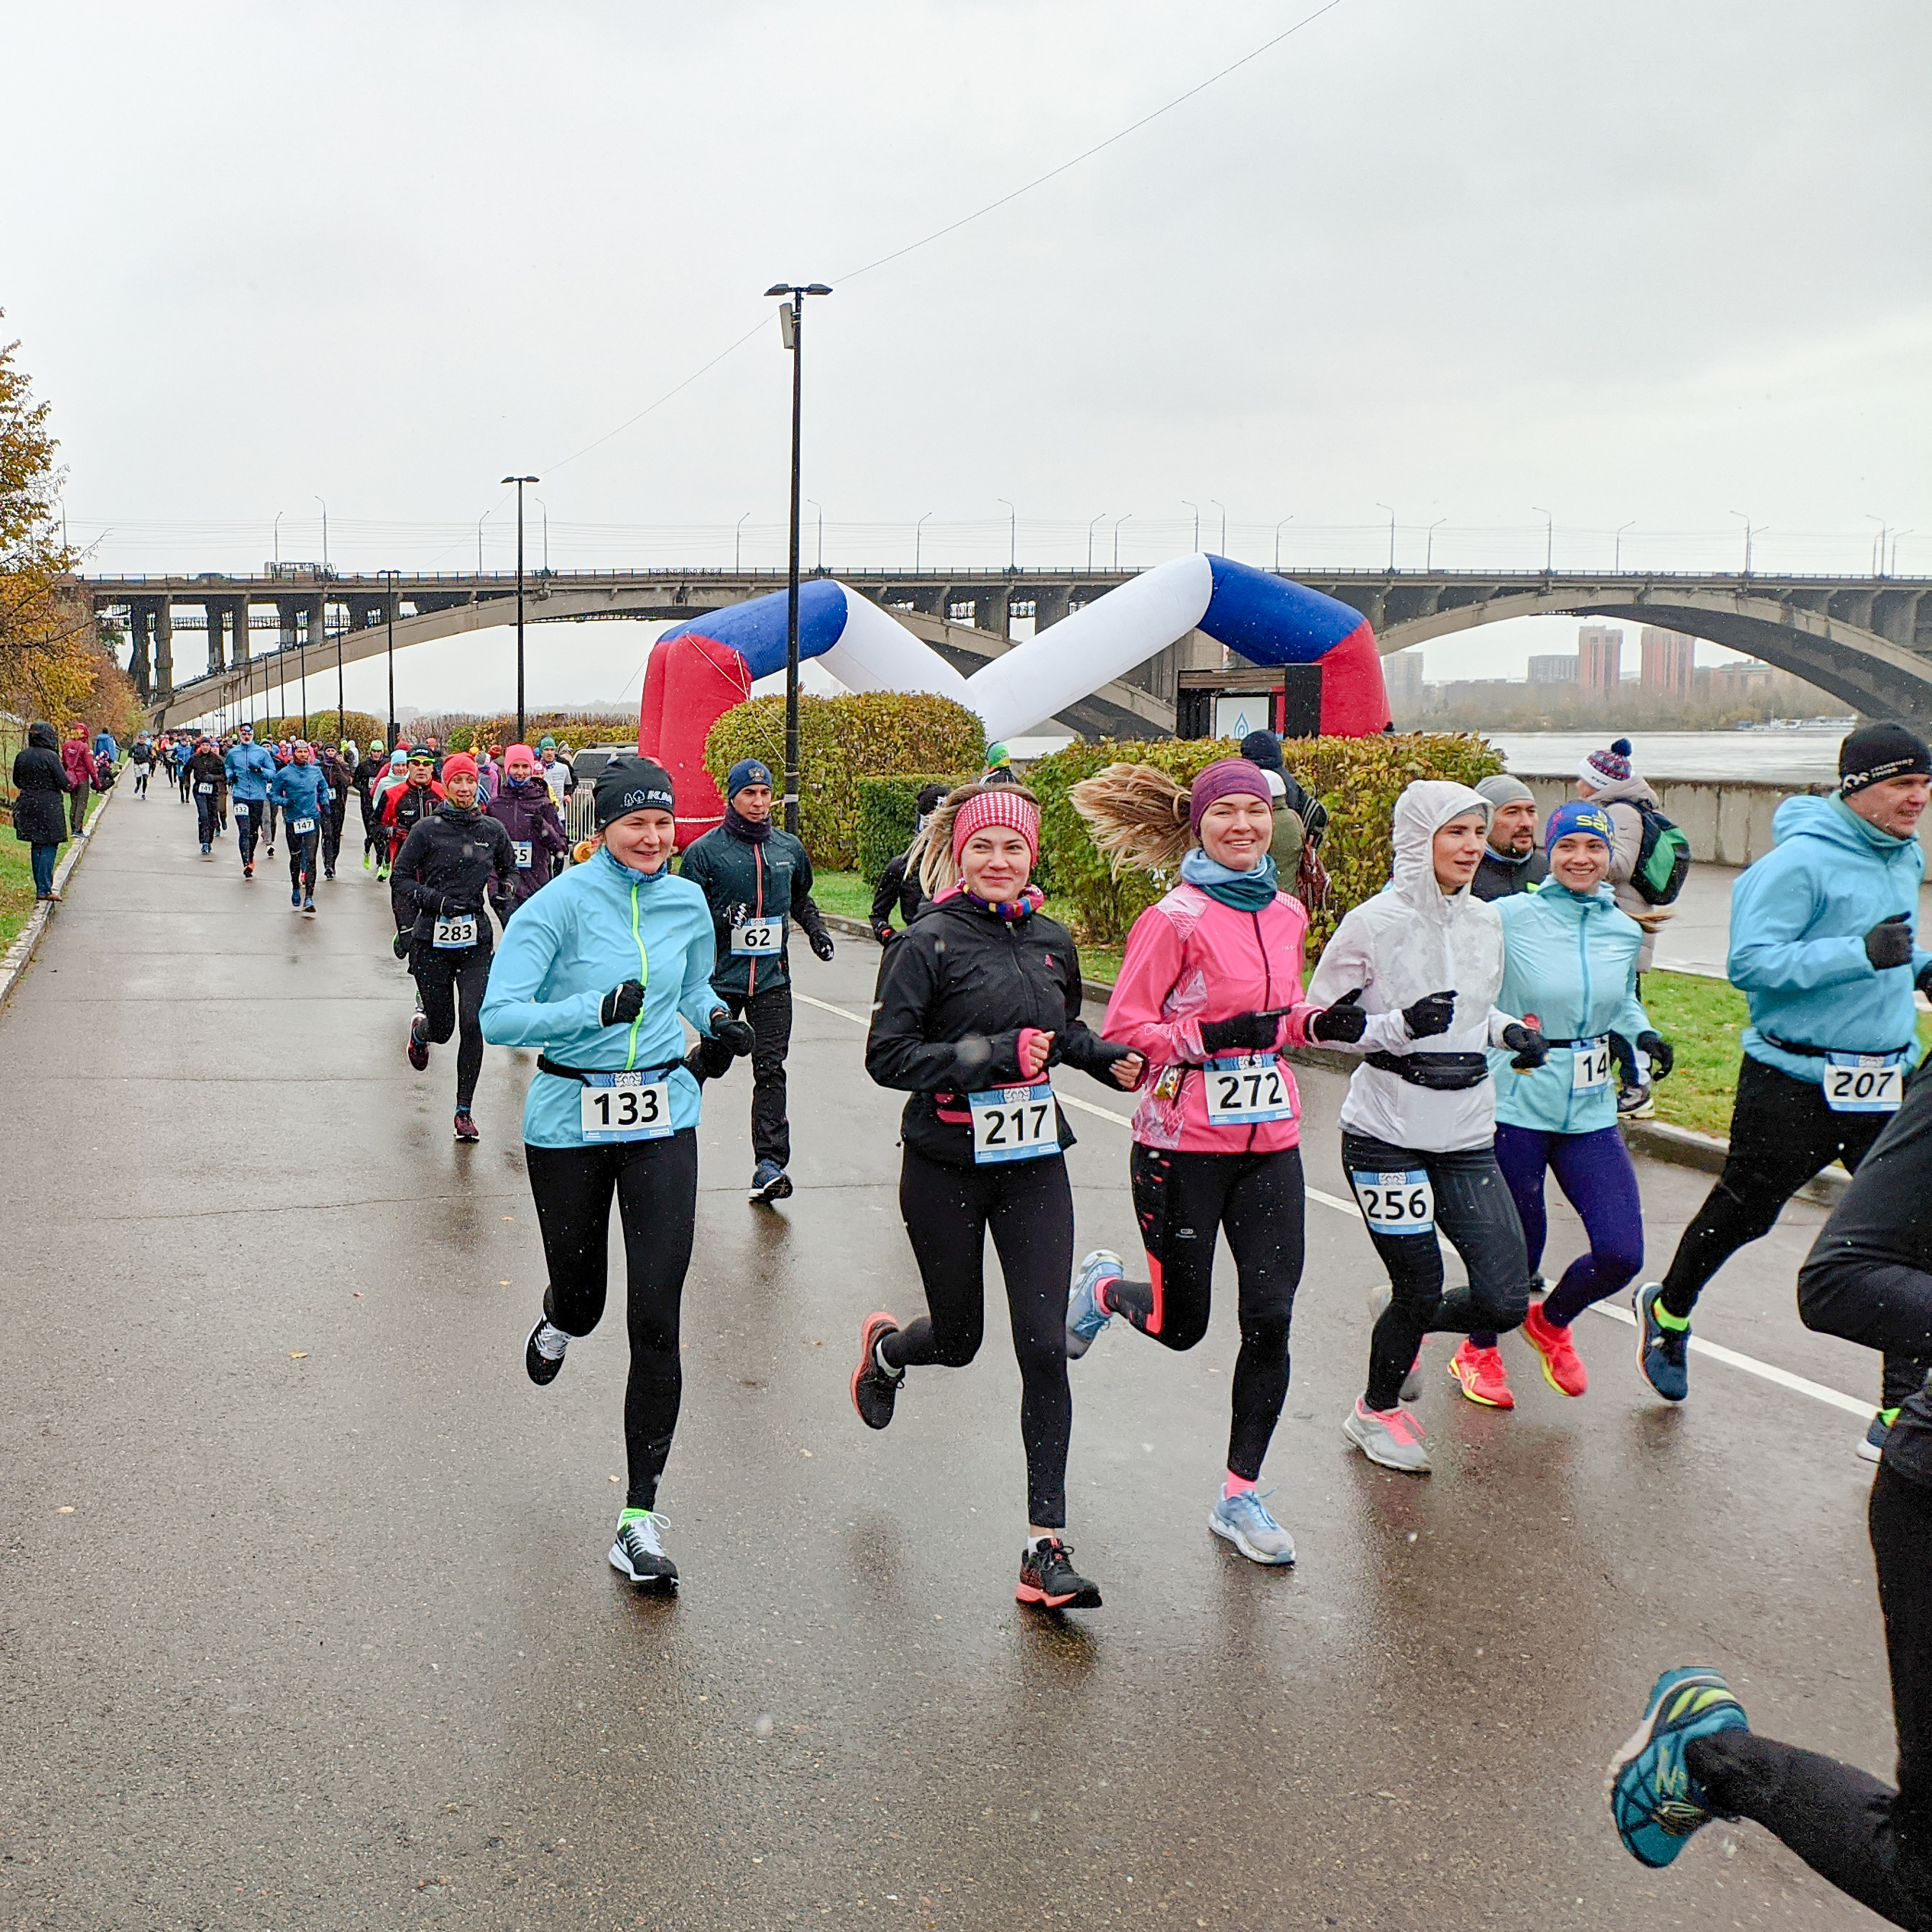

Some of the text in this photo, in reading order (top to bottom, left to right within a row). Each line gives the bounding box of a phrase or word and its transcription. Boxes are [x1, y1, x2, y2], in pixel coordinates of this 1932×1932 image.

[296, 821, 312, 830] 147
[439, 924, 472, 941] 283
[744, 927, 770, 947] 62
[1217, 1072, 1283, 1109] 272
[1834, 1070, 1895, 1098] 207
[593, 1089, 659, 1126] 133
[983, 1104, 1048, 1145] 217
[1362, 1188, 1426, 1220] 256
